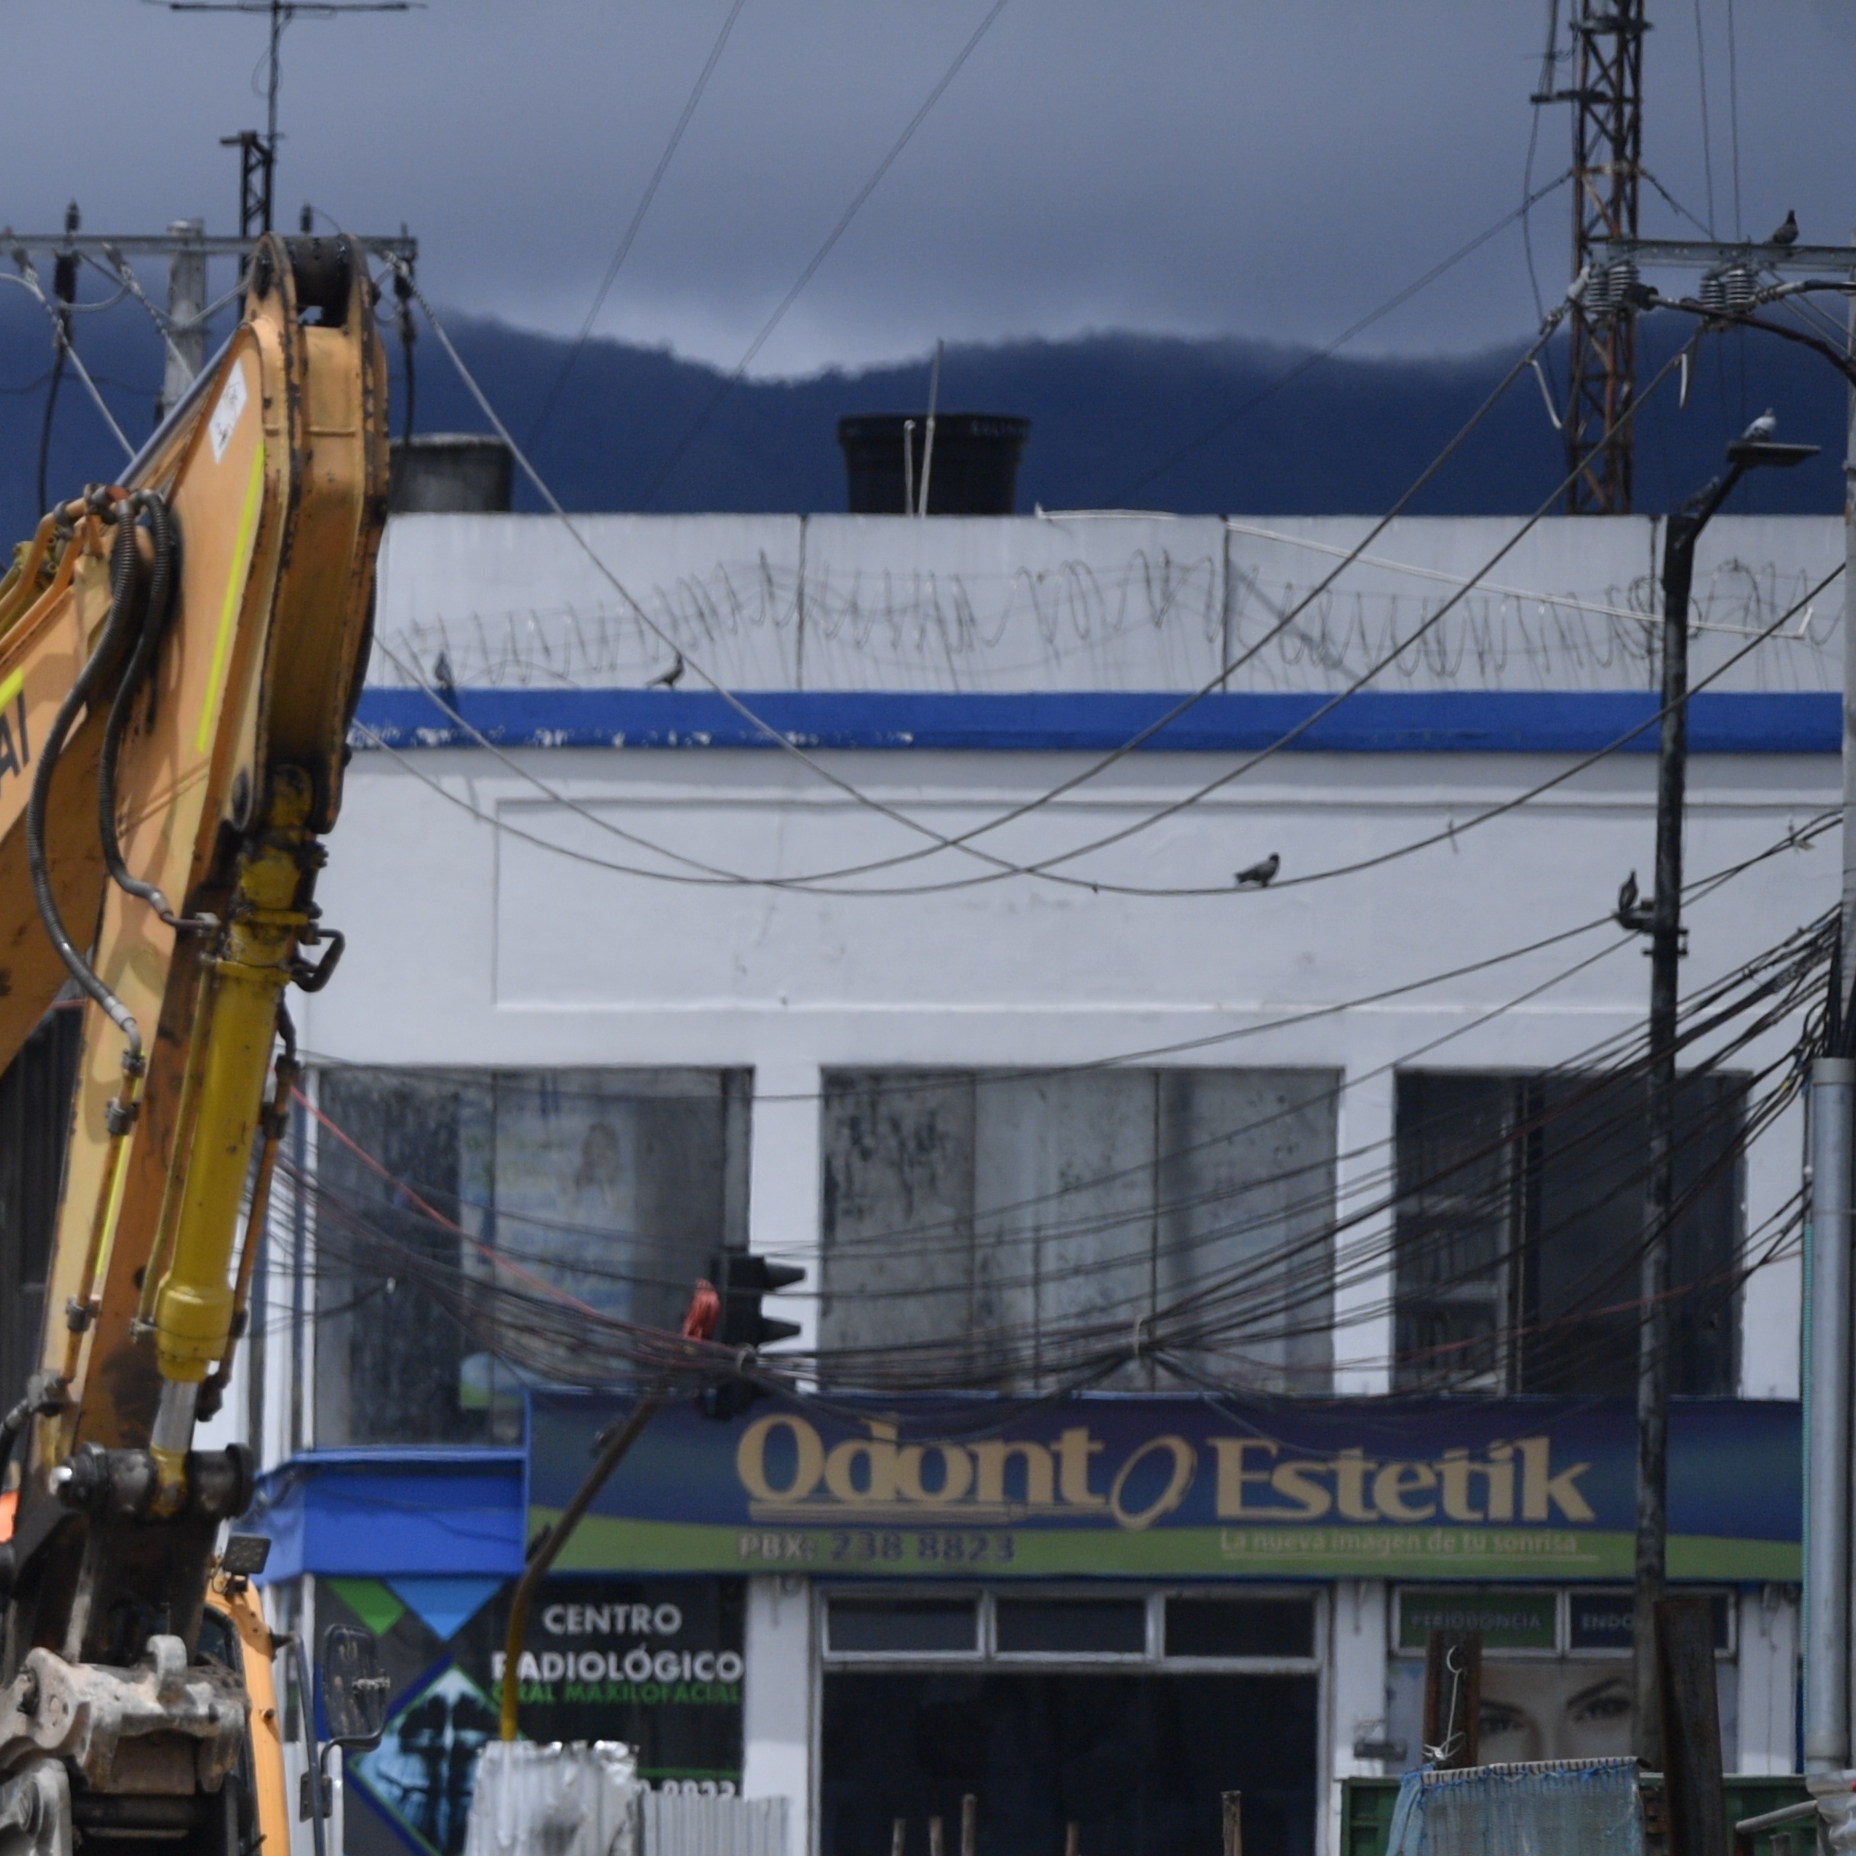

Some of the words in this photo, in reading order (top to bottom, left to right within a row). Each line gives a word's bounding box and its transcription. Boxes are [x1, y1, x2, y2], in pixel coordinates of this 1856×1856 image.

[1208, 1435, 1598, 1523] Estetik
[831, 1533, 903, 1562] 238
[917, 1533, 1015, 1562] 8823
[1220, 1530, 1246, 1551] La
[1253, 1534, 1326, 1552] nueva
[1332, 1531, 1420, 1556] imagen
[1427, 1531, 1456, 1552] de
[1462, 1533, 1487, 1552] tu
[1492, 1533, 1578, 1554] sonrisa
[542, 1603, 682, 1635] CENTRO
[564, 1682, 741, 1704] MAXILOFACIAL
